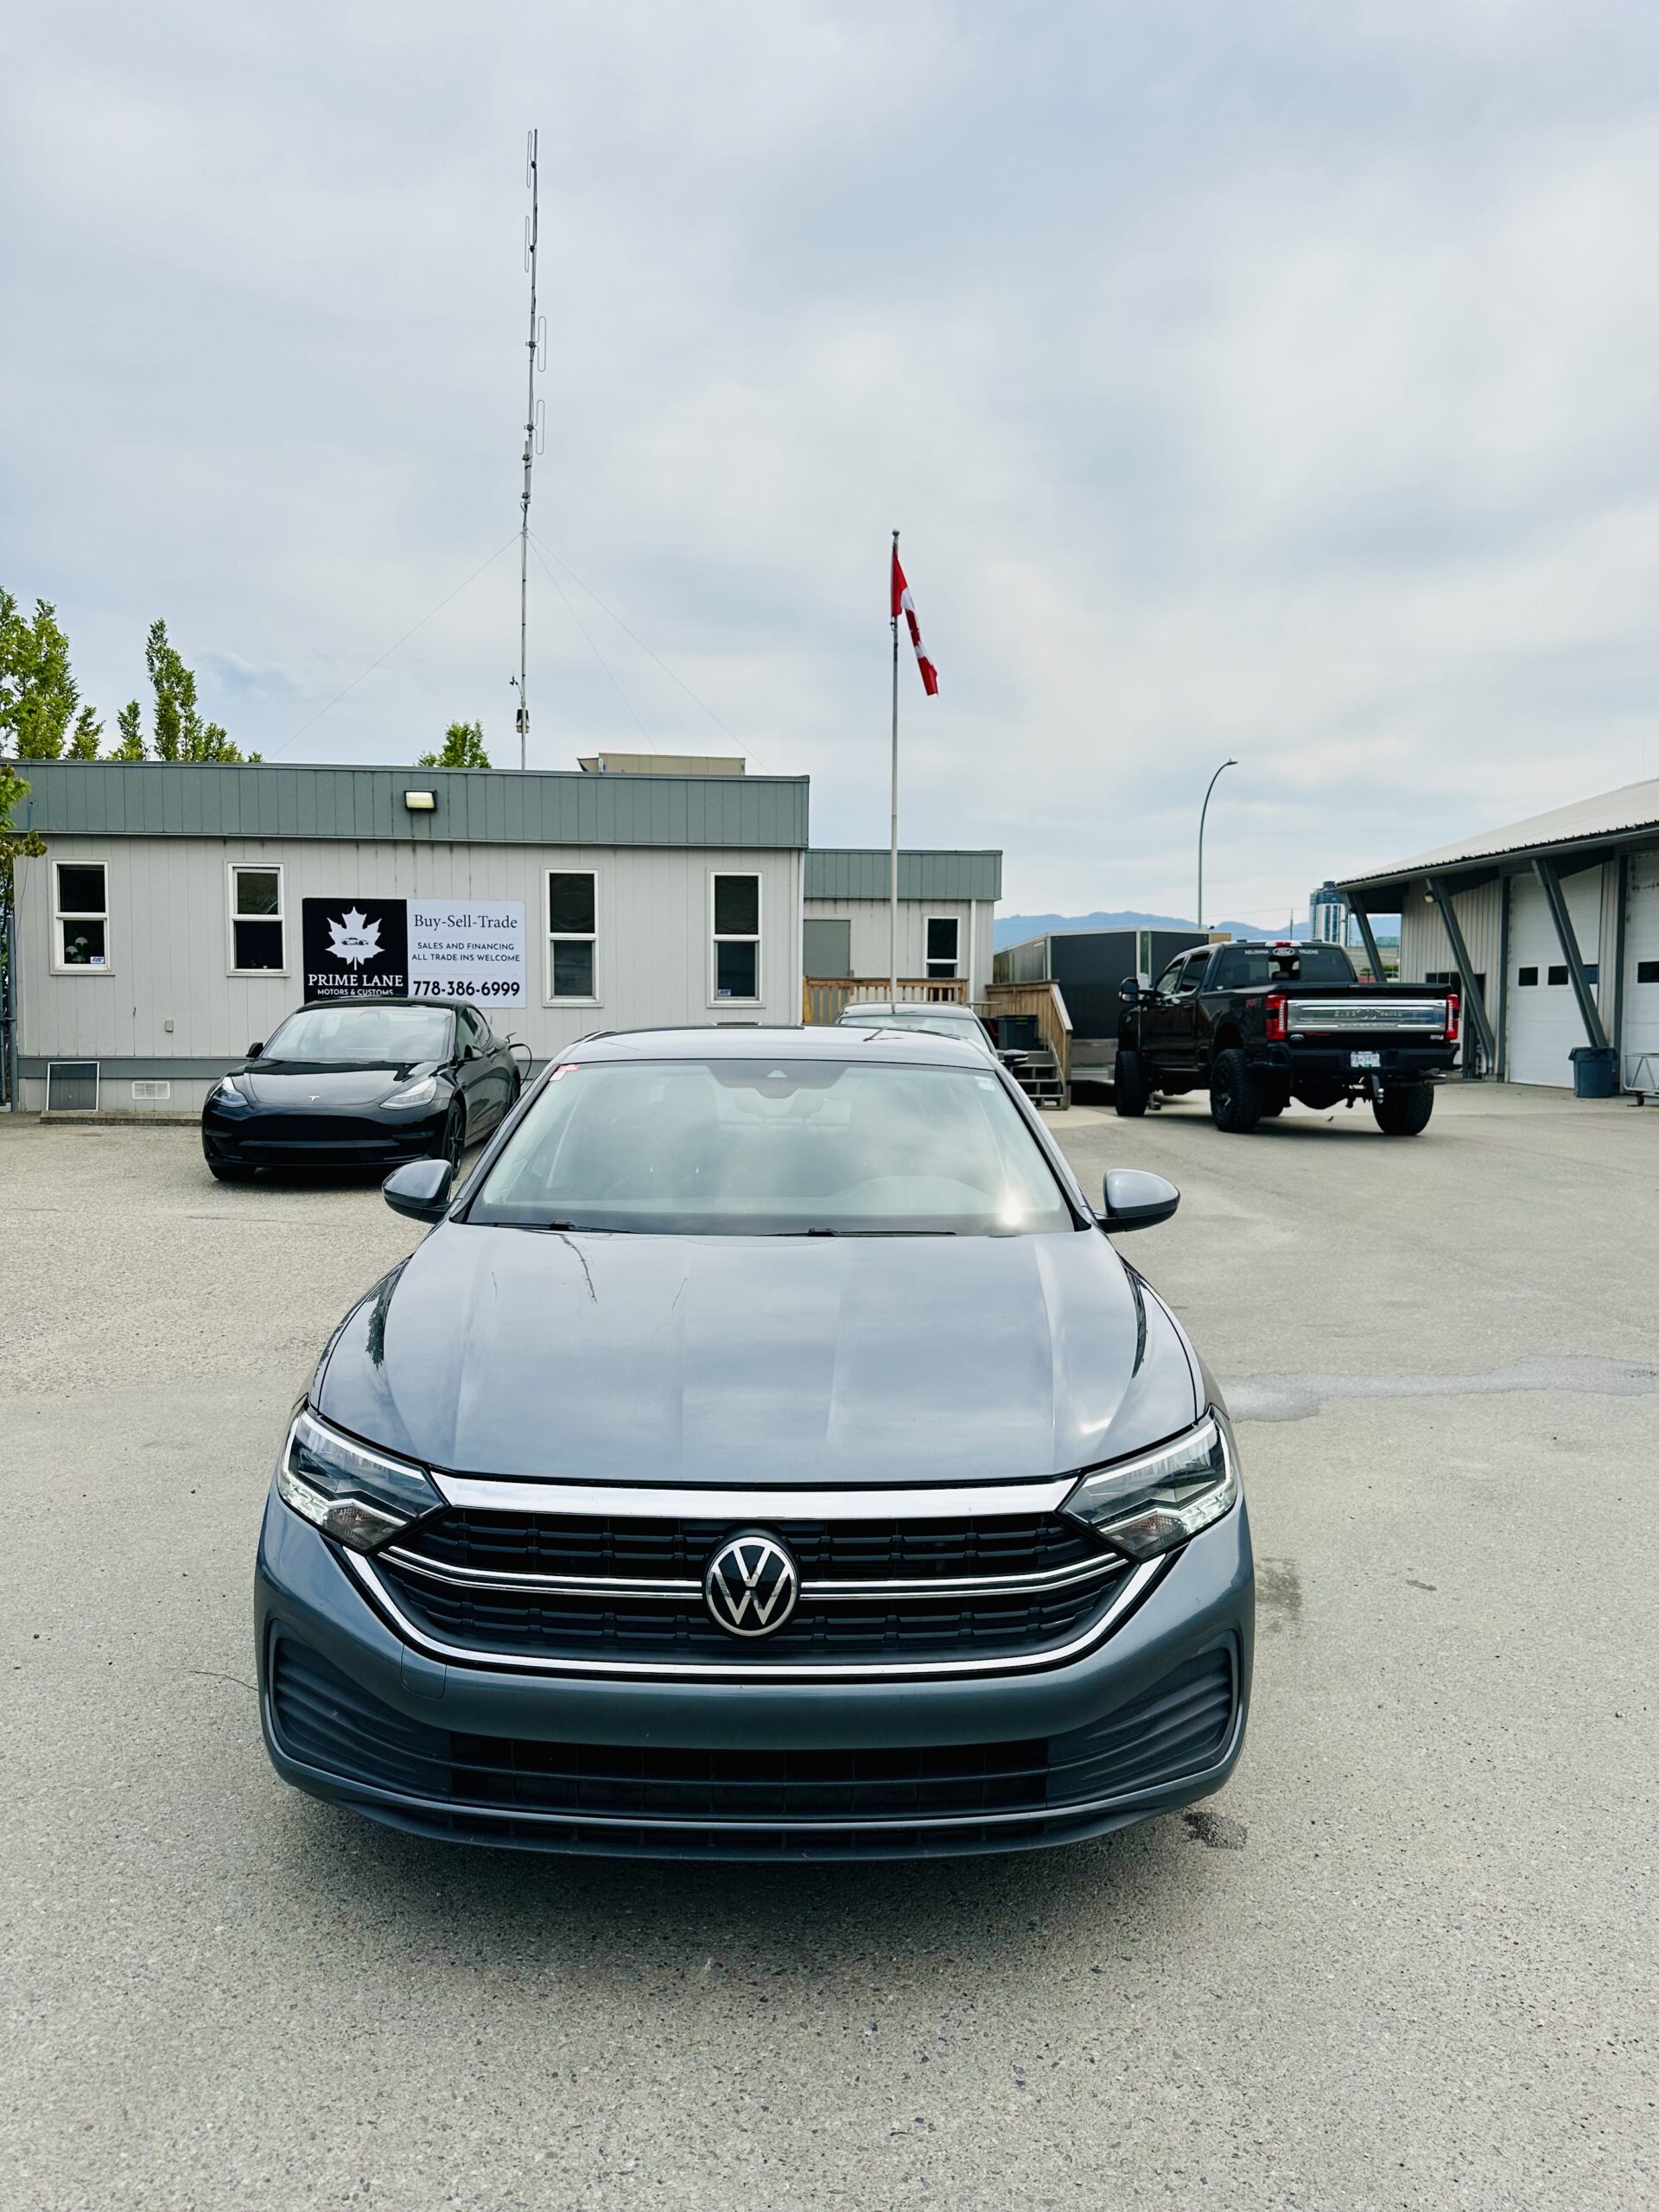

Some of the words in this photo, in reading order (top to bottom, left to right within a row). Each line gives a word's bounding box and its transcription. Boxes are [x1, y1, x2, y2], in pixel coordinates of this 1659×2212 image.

[415, 914, 518, 931] Buy-Sell-Trade
[308, 974, 359, 986] PRIME
[362, 975, 404, 987] LANE
[413, 981, 520, 996] 778-386-6999
